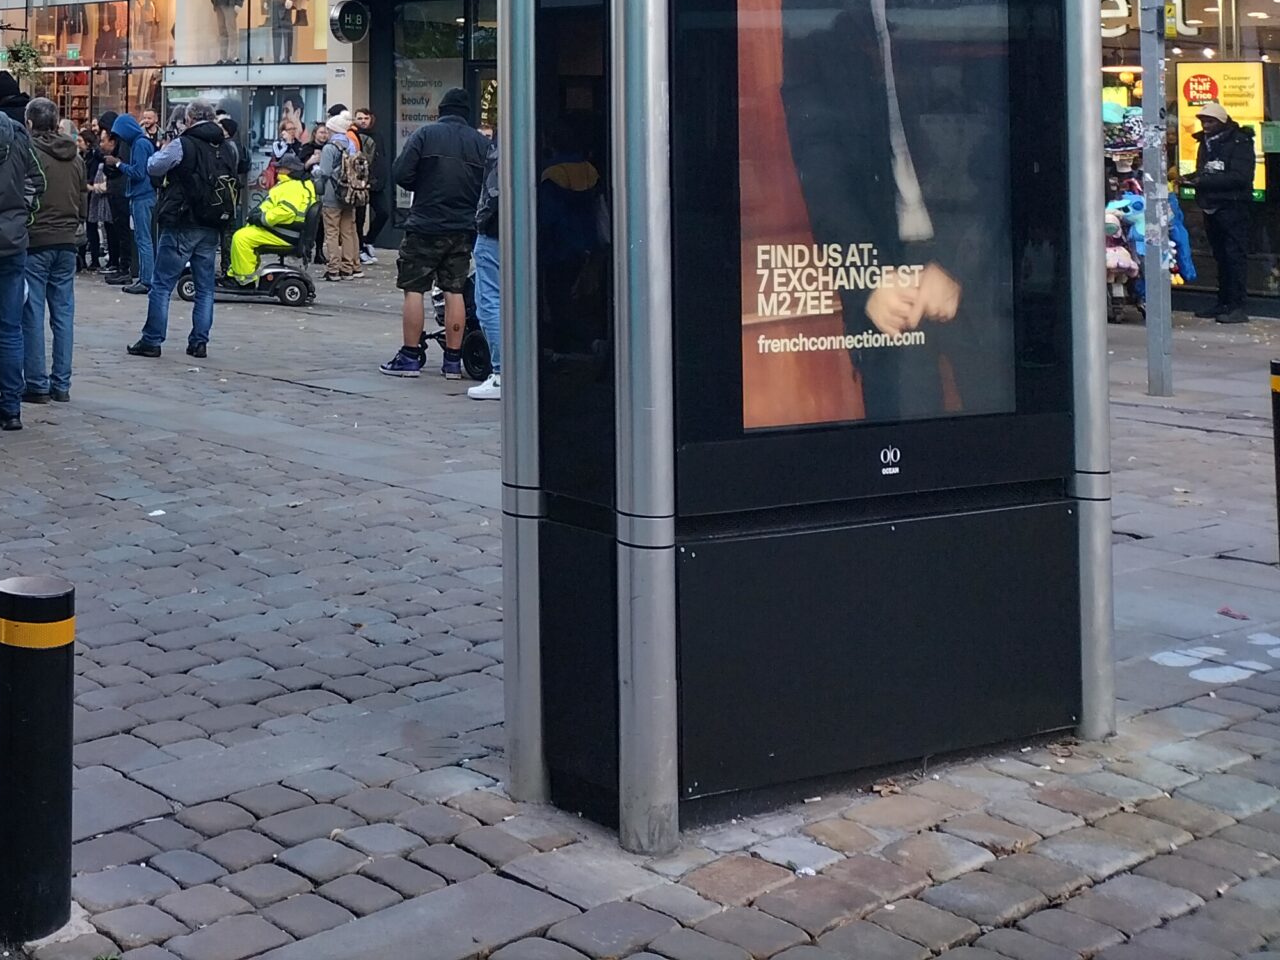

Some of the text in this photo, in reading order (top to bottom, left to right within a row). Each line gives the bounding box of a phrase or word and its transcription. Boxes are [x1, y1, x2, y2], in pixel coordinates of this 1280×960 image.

[1189, 81, 1211, 90] Half
[1190, 90, 1212, 99] Price
[401, 96, 430, 106] beauty
[481, 80, 498, 126] RUSTE
[401, 112, 439, 121] treatmen
[756, 243, 878, 268] FIND US AT:
[756, 264, 924, 292] 7 EXCHANGE ST
[757, 291, 834, 316] M2 7EE
[757, 330, 925, 353] frenchconnection.com
